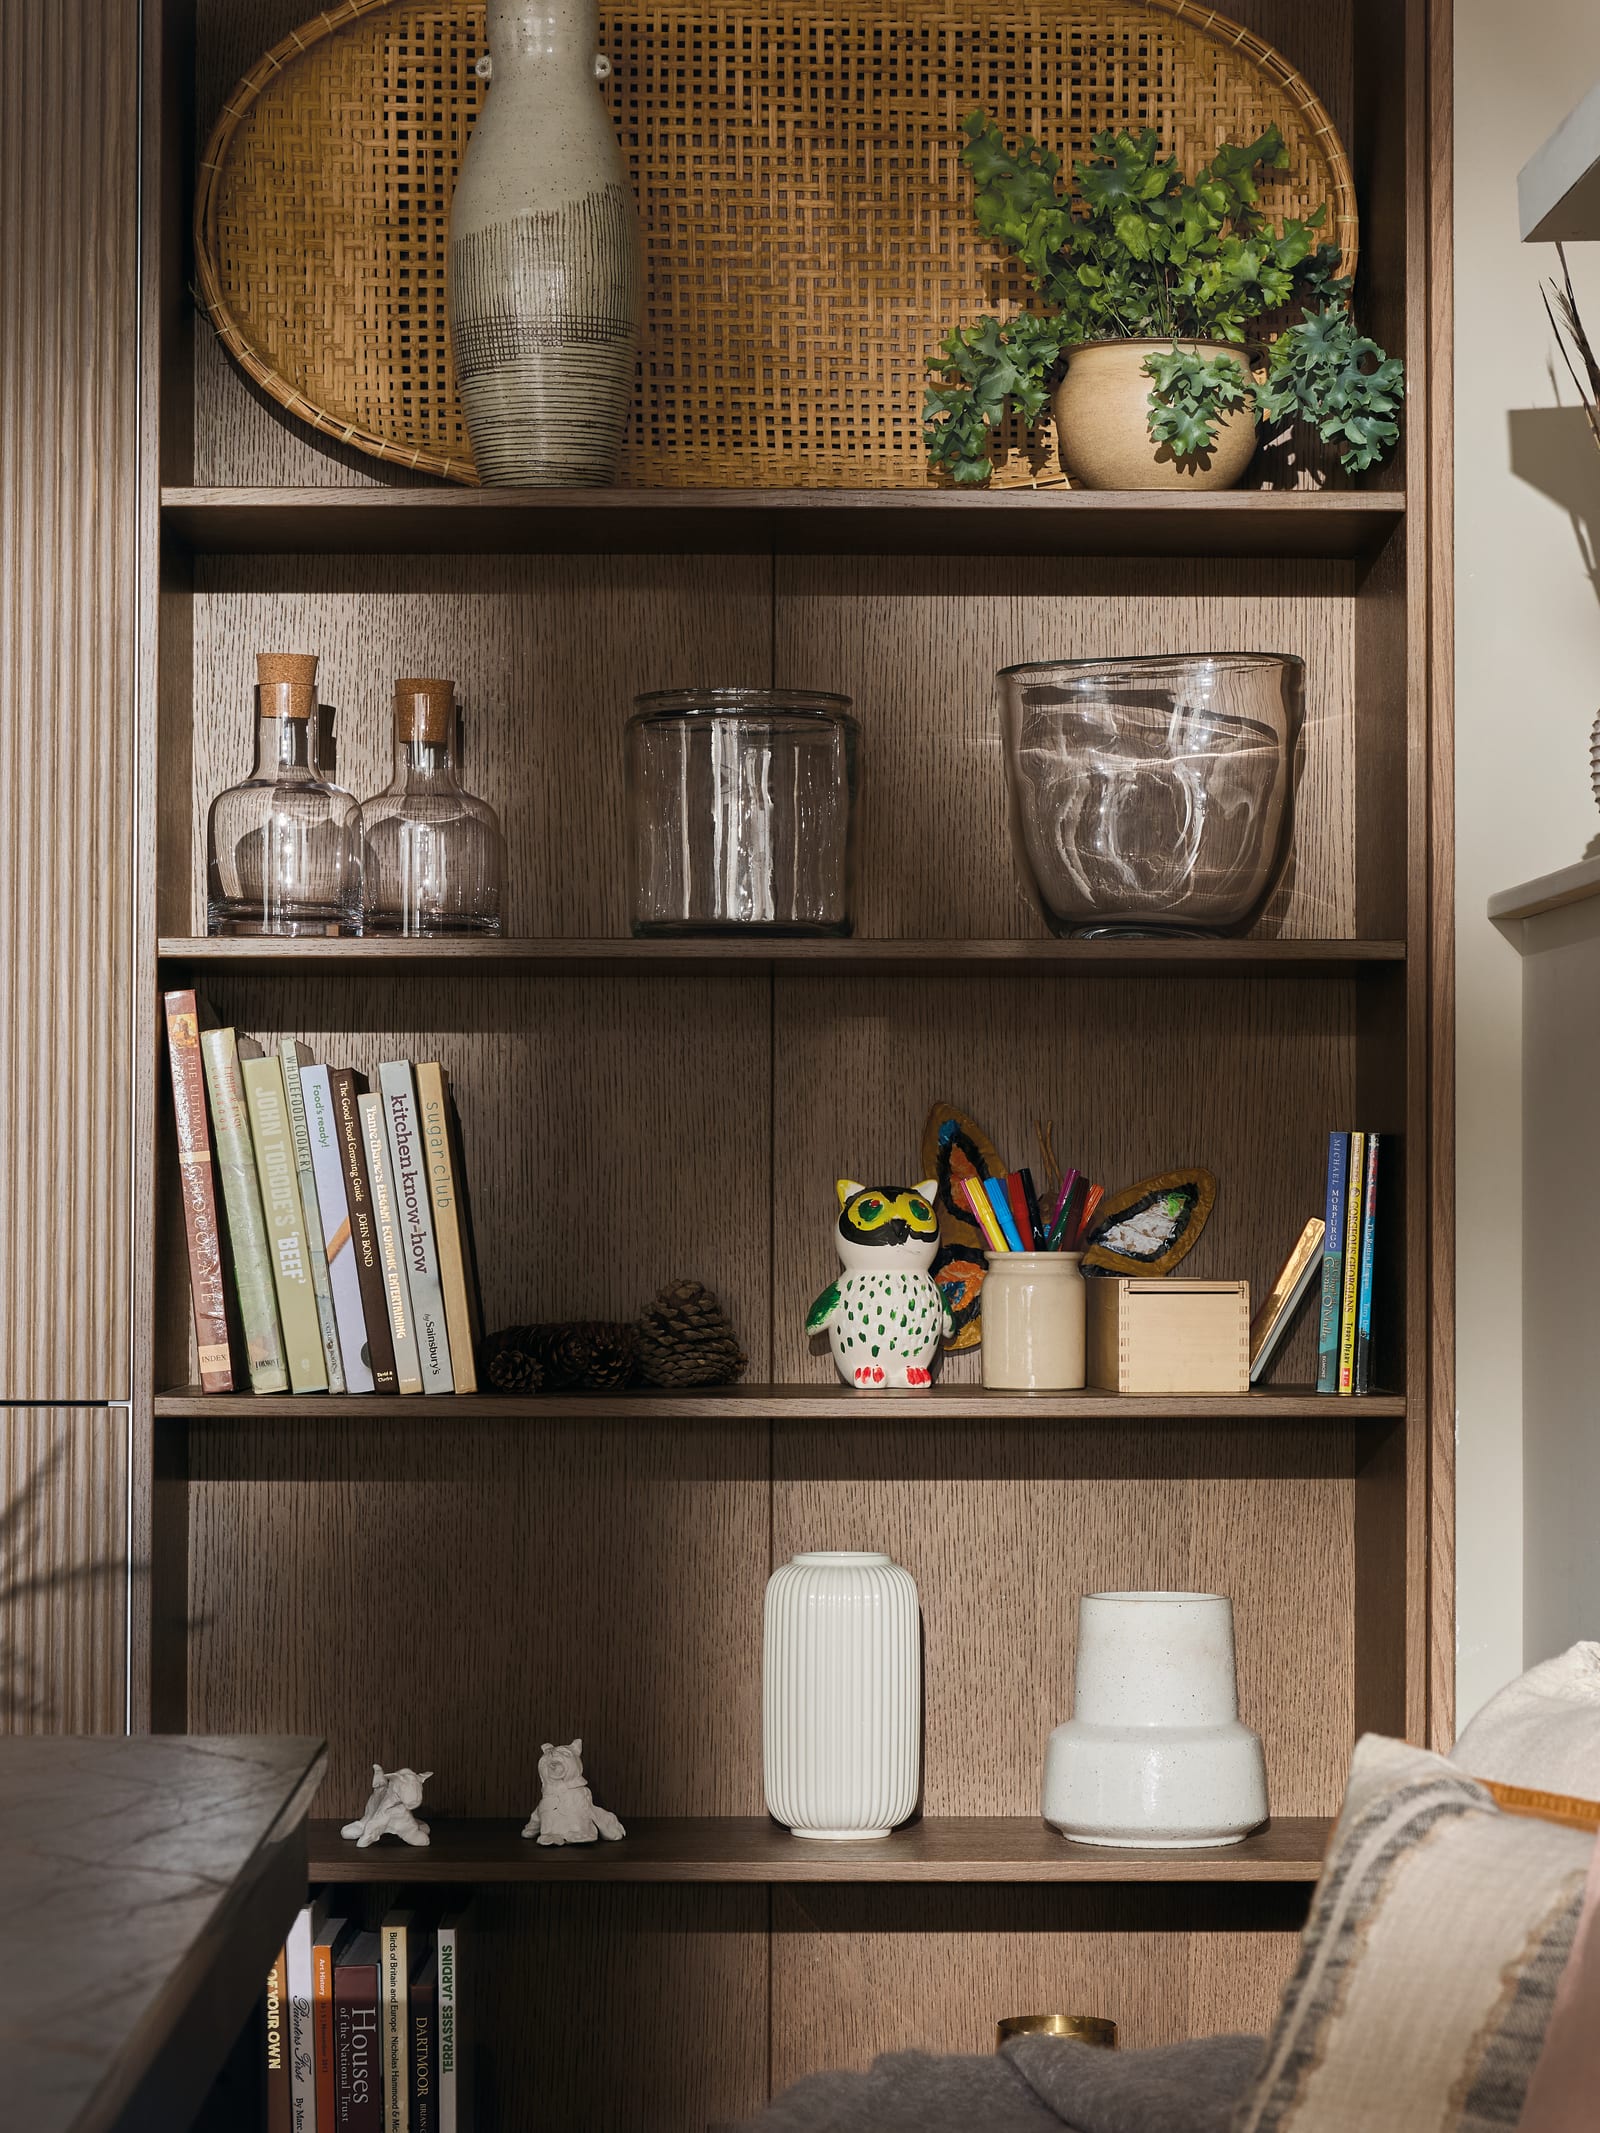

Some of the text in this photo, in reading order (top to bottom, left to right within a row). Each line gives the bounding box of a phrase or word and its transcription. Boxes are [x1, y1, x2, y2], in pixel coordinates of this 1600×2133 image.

[190, 1084, 204, 1149] ULTIMATE
[255, 1087, 284, 1136] JOHN
[286, 1055, 312, 1174] WHOLEFOOD COOKERY
[312, 1084, 330, 1148] Food's ready!
[339, 1081, 364, 1202] The Good Food Growing Guide
[263, 1141, 297, 1226] TORODE'S
[390, 1093, 427, 1274] kitchen know-how
[426, 1102, 453, 1209] sugar club
[1330, 1138, 1341, 1249] MICHAEL MORPURGO
[189, 1164, 214, 1304] CHOCOLATE
[356, 1212, 374, 1268] JOHN BOND
[1345, 1201, 1359, 1313] GORGEOUS GEORGIANS
[1365, 1238, 1373, 1261] Rotten
[388, 1273, 407, 1339] ENTERTAINING
[201, 1355, 227, 1364] INDEX
[425, 1321, 441, 1375] Sainsbury's
[267, 1989, 280, 2029] YOUR
[318, 1971, 326, 1996] History
[388, 1932, 398, 2033] Birds of Britain and Europe
[442, 1945, 454, 2074] TERRASSES JARDINS
[268, 2031, 281, 2069] OWN
[293, 1995, 312, 2083] Painters First
[339, 2007, 351, 2122] of the National Trust
[351, 2007, 377, 2104] Houses
[390, 2036, 400, 2069] Nicholas
[415, 2017, 429, 2097] DARTMOOR
[295, 2098, 304, 2130] By Marc
[391, 2070, 400, 2109] Hammond
[419, 2103, 427, 2127] BRIAN
